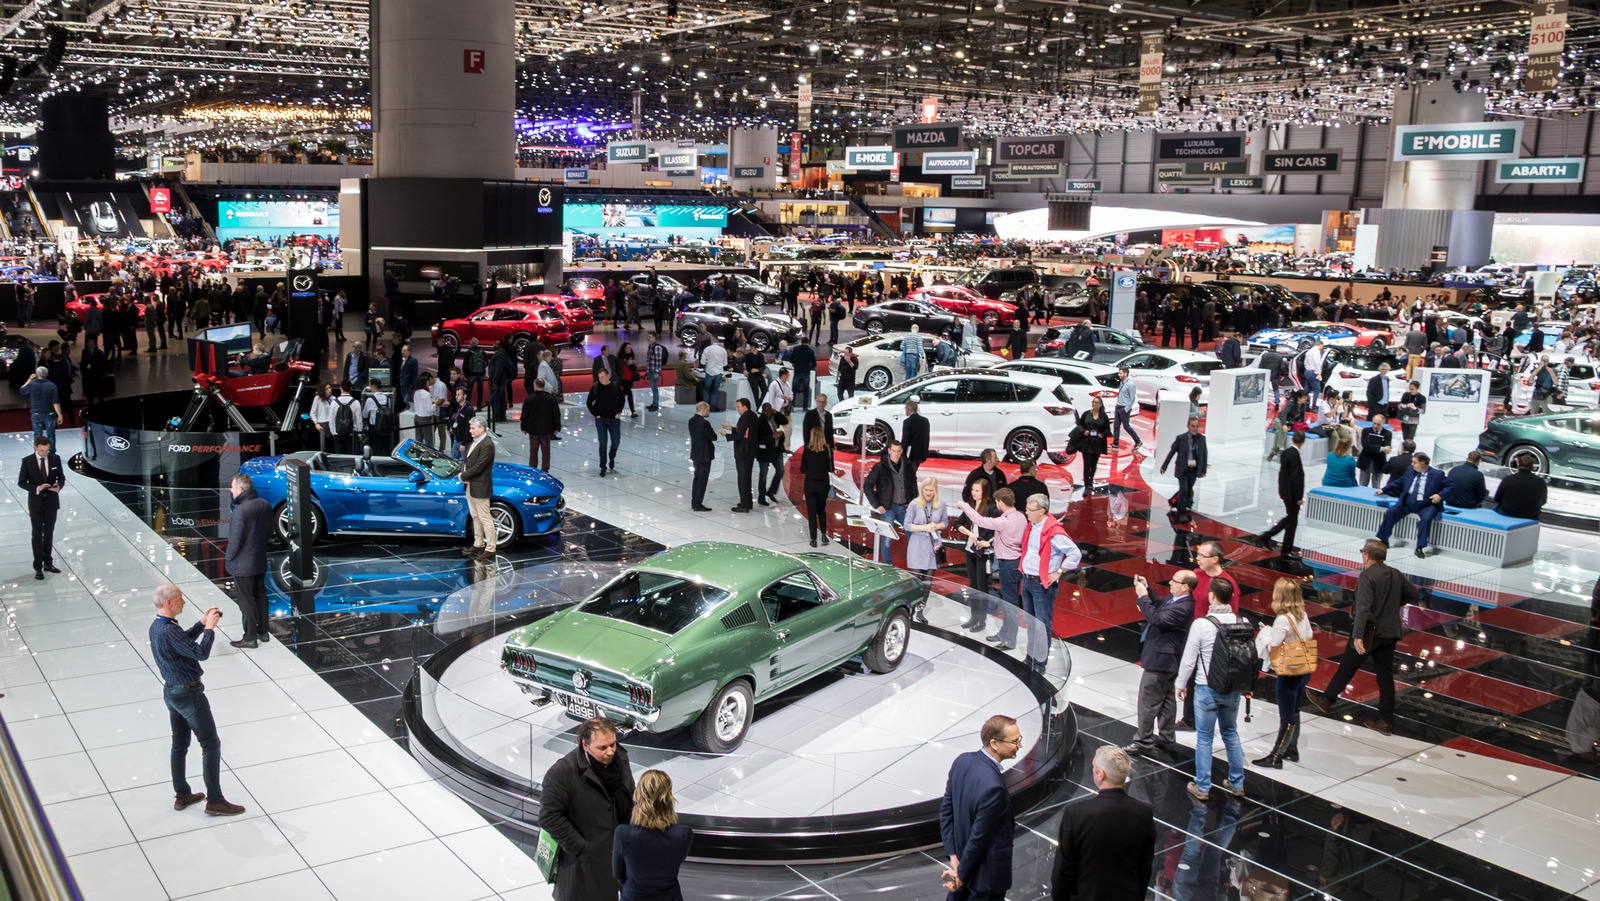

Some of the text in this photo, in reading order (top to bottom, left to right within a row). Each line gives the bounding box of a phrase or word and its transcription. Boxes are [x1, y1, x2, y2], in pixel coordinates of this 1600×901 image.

[1545, 4, 1555, 16] 5
[1536, 21, 1562, 31] ALLÉE
[1531, 31, 1564, 45] 5100
[1149, 45, 1155, 54] 5
[470, 51, 481, 68] F
[1527, 55, 1563, 65] HALLES
[1141, 66, 1161, 76] 5000
[907, 131, 945, 144] MAZDA
[1413, 133, 1501, 150] E'MOBILE
[1184, 140, 1215, 148] LUXARIA
[615, 147, 639, 157] SUZUKI
[1008, 143, 1055, 156] TOPCAR
[1175, 148, 1224, 156] TECHNOLOGY
[664, 155, 689, 165] KLASSEN
[856, 153, 887, 163] E-MOKE
[1274, 157, 1327, 167] SIN CARS
[1203, 162, 1227, 171] FIAT
[1511, 165, 1567, 176] ABARTH
[168, 444, 262, 453] FORD PERFORMANCE
